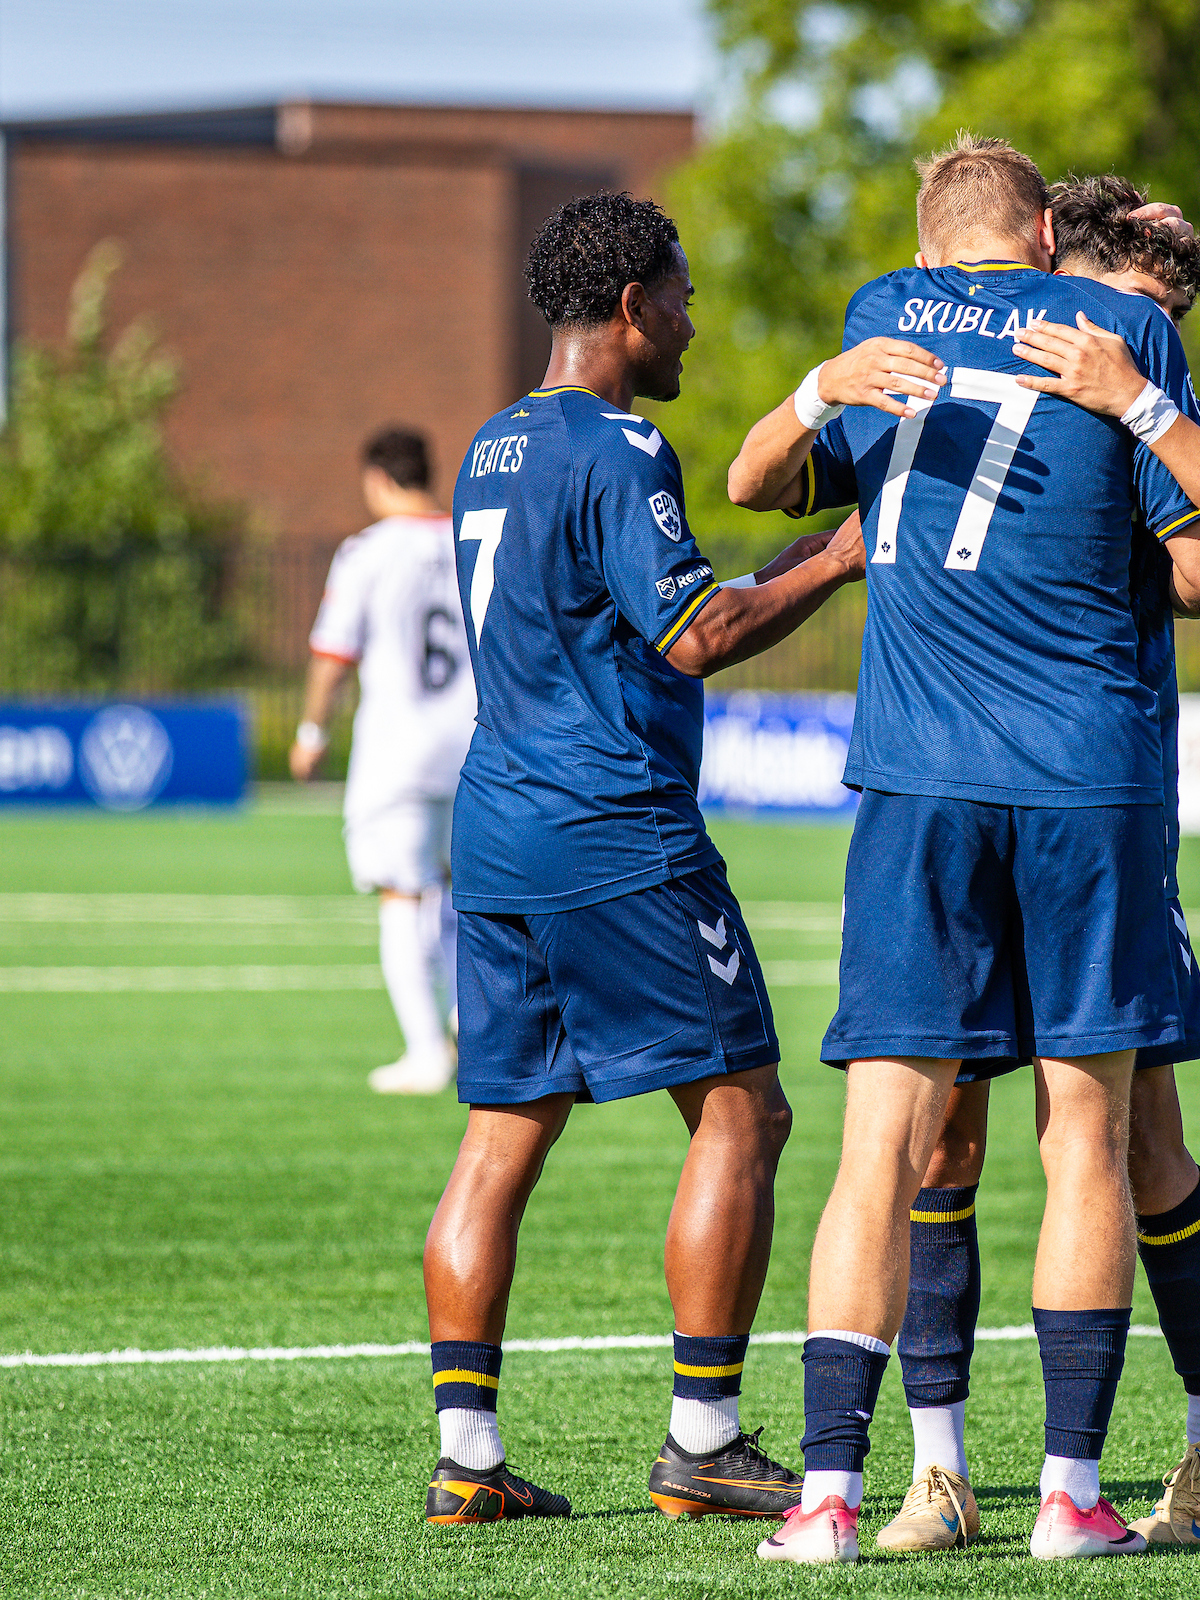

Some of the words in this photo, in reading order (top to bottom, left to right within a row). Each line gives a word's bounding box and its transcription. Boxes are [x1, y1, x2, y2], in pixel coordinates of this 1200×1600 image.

[469, 435, 528, 478] YEATES
[869, 366, 1040, 571] 77
[458, 508, 508, 651] 7
[419, 603, 457, 693] 6
